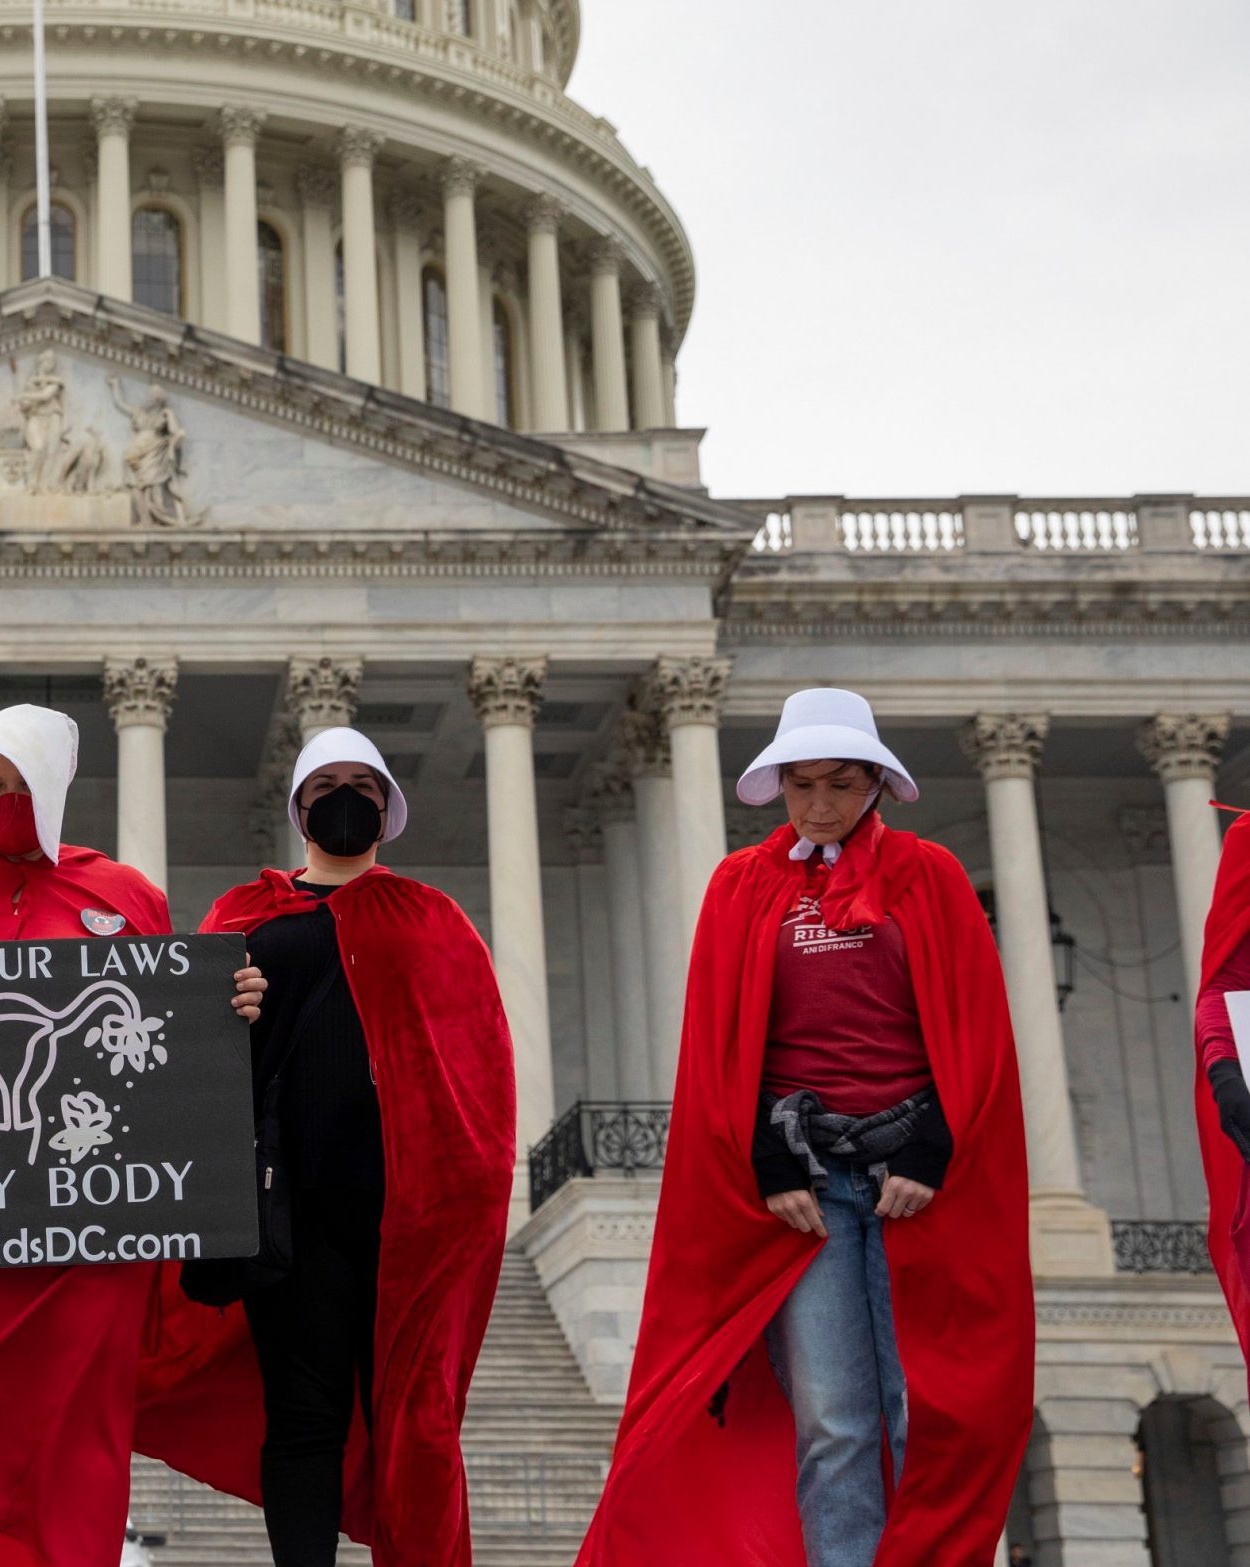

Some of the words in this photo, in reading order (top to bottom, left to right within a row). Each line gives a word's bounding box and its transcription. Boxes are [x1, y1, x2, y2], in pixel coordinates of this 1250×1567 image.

[794, 928, 838, 941] RISE
[80, 941, 190, 977] LAWS
[48, 1160, 193, 1207] BODY
